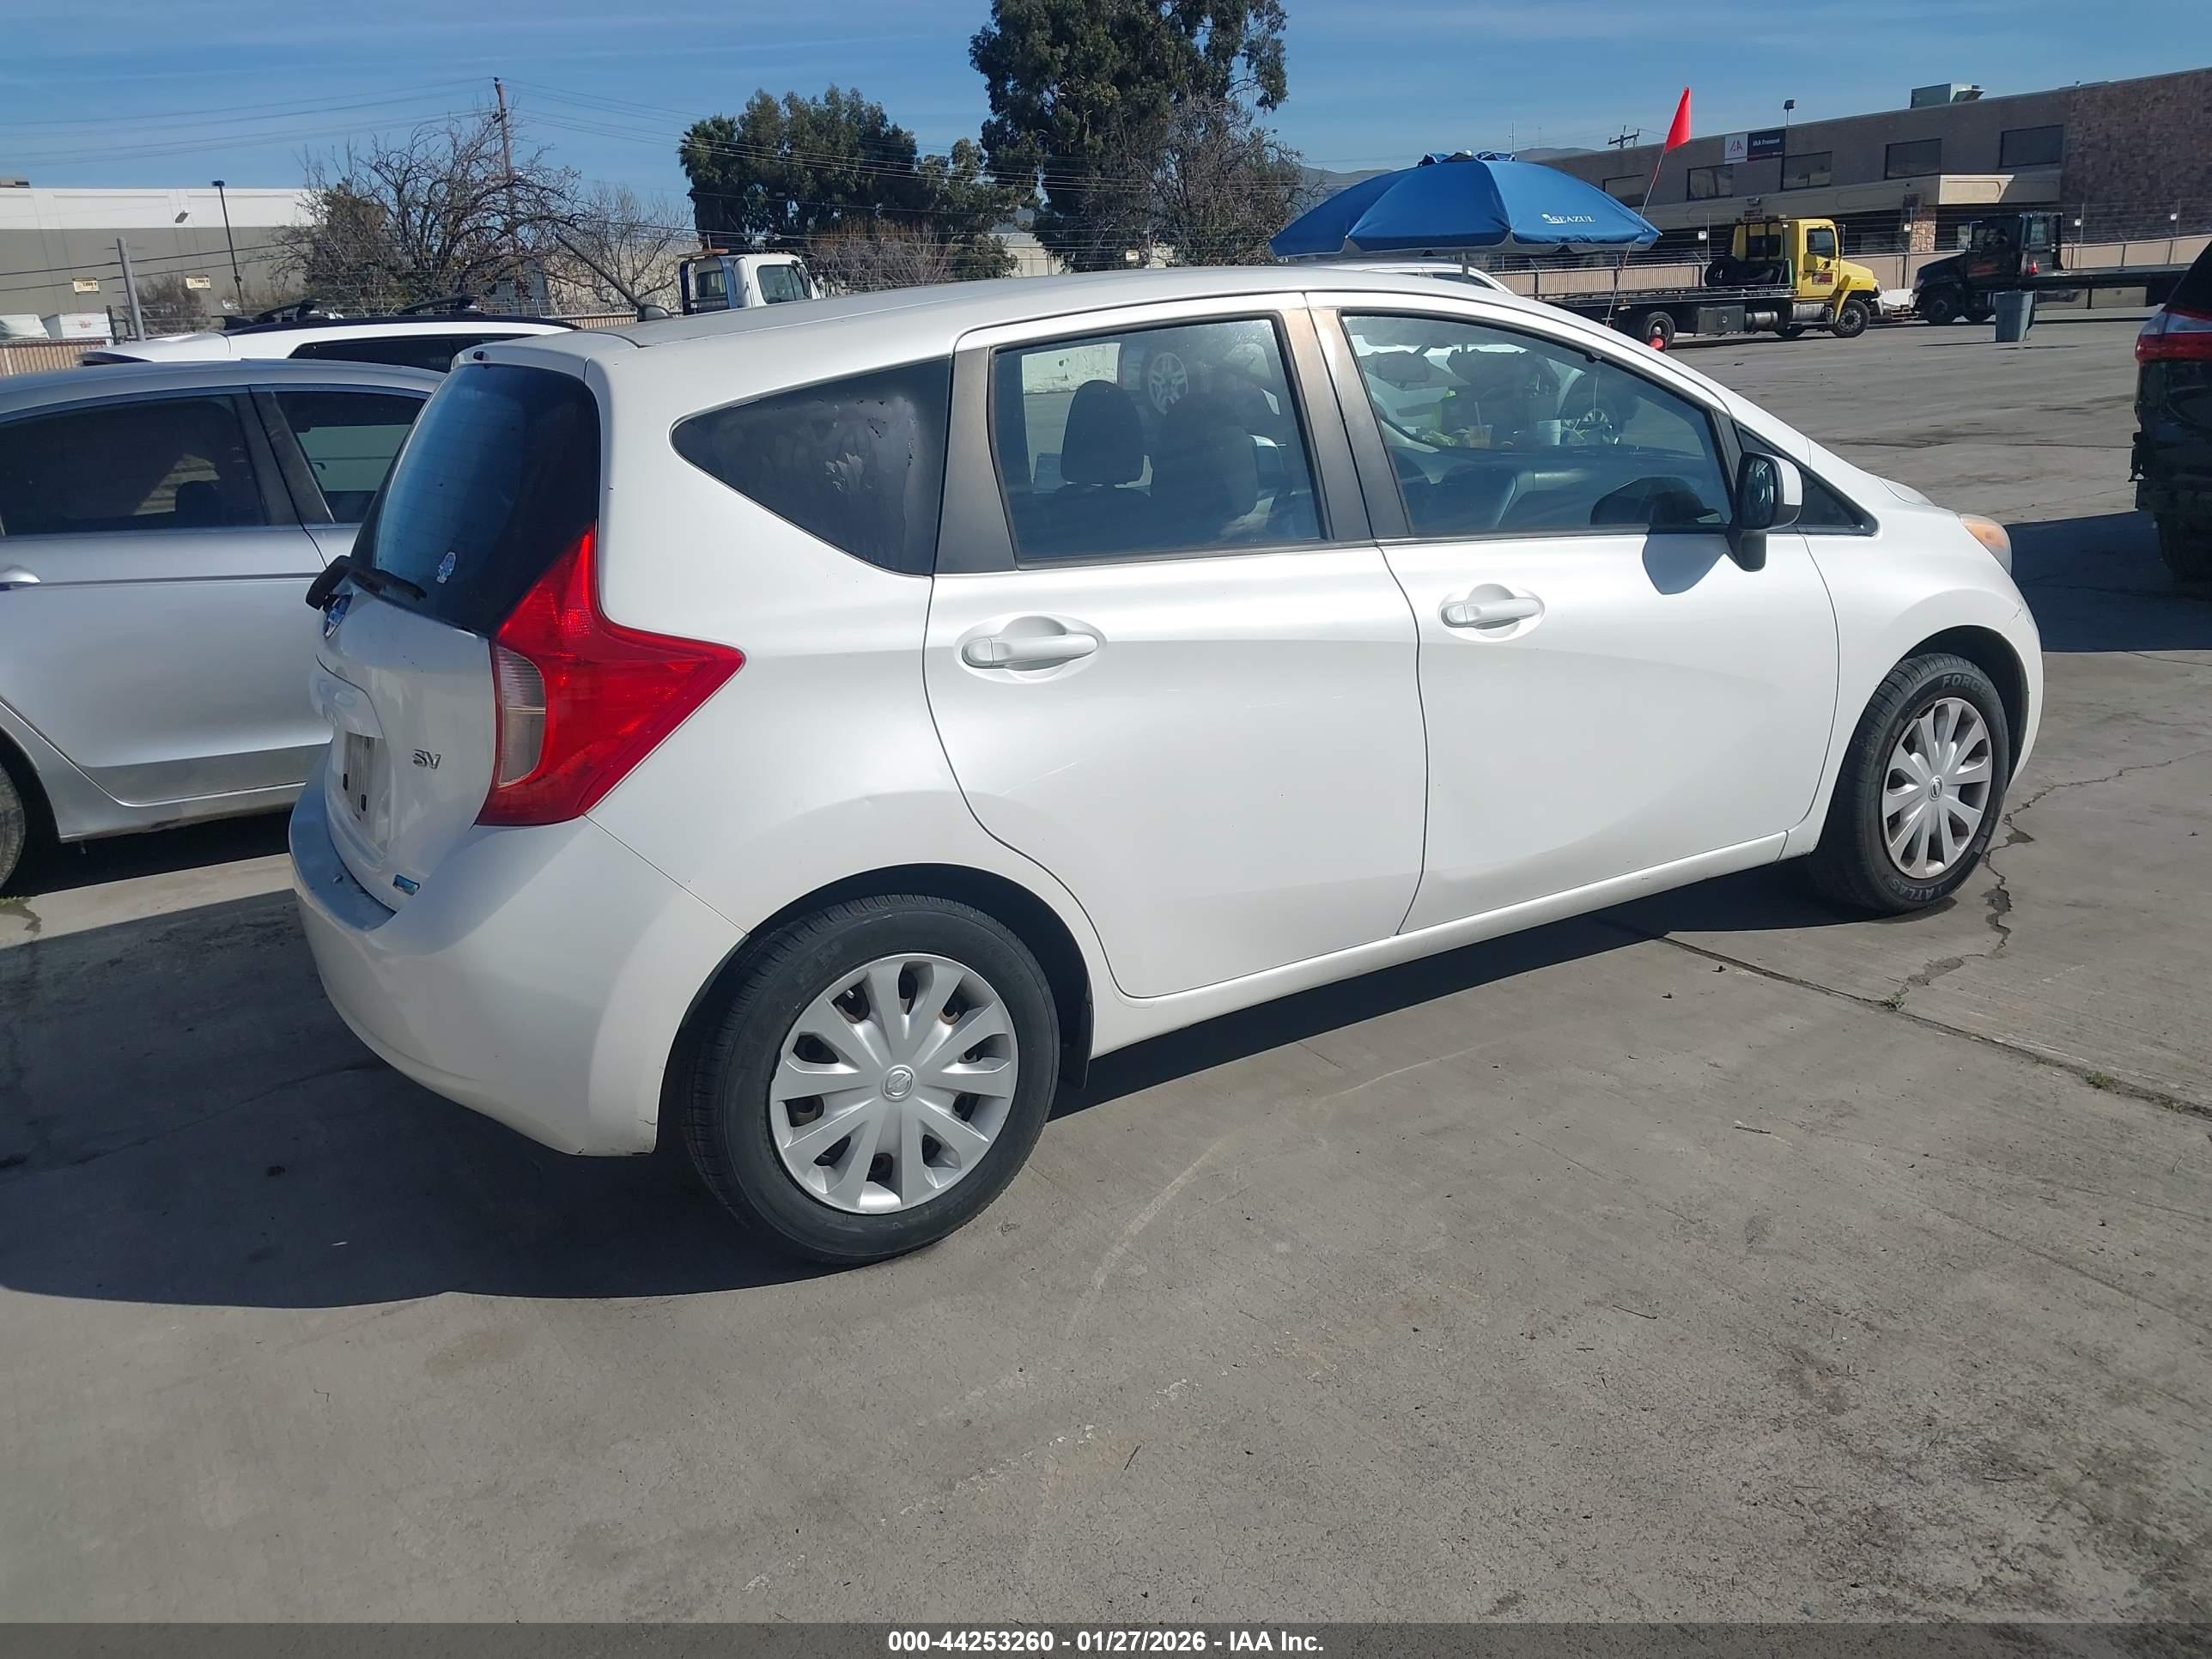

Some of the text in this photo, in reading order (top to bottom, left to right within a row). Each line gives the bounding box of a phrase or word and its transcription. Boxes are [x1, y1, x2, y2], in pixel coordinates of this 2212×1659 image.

[1942, 674, 1987, 696] FORCE
[412, 749, 441, 769] SV
[1888, 878, 1935, 901] ATLAS
